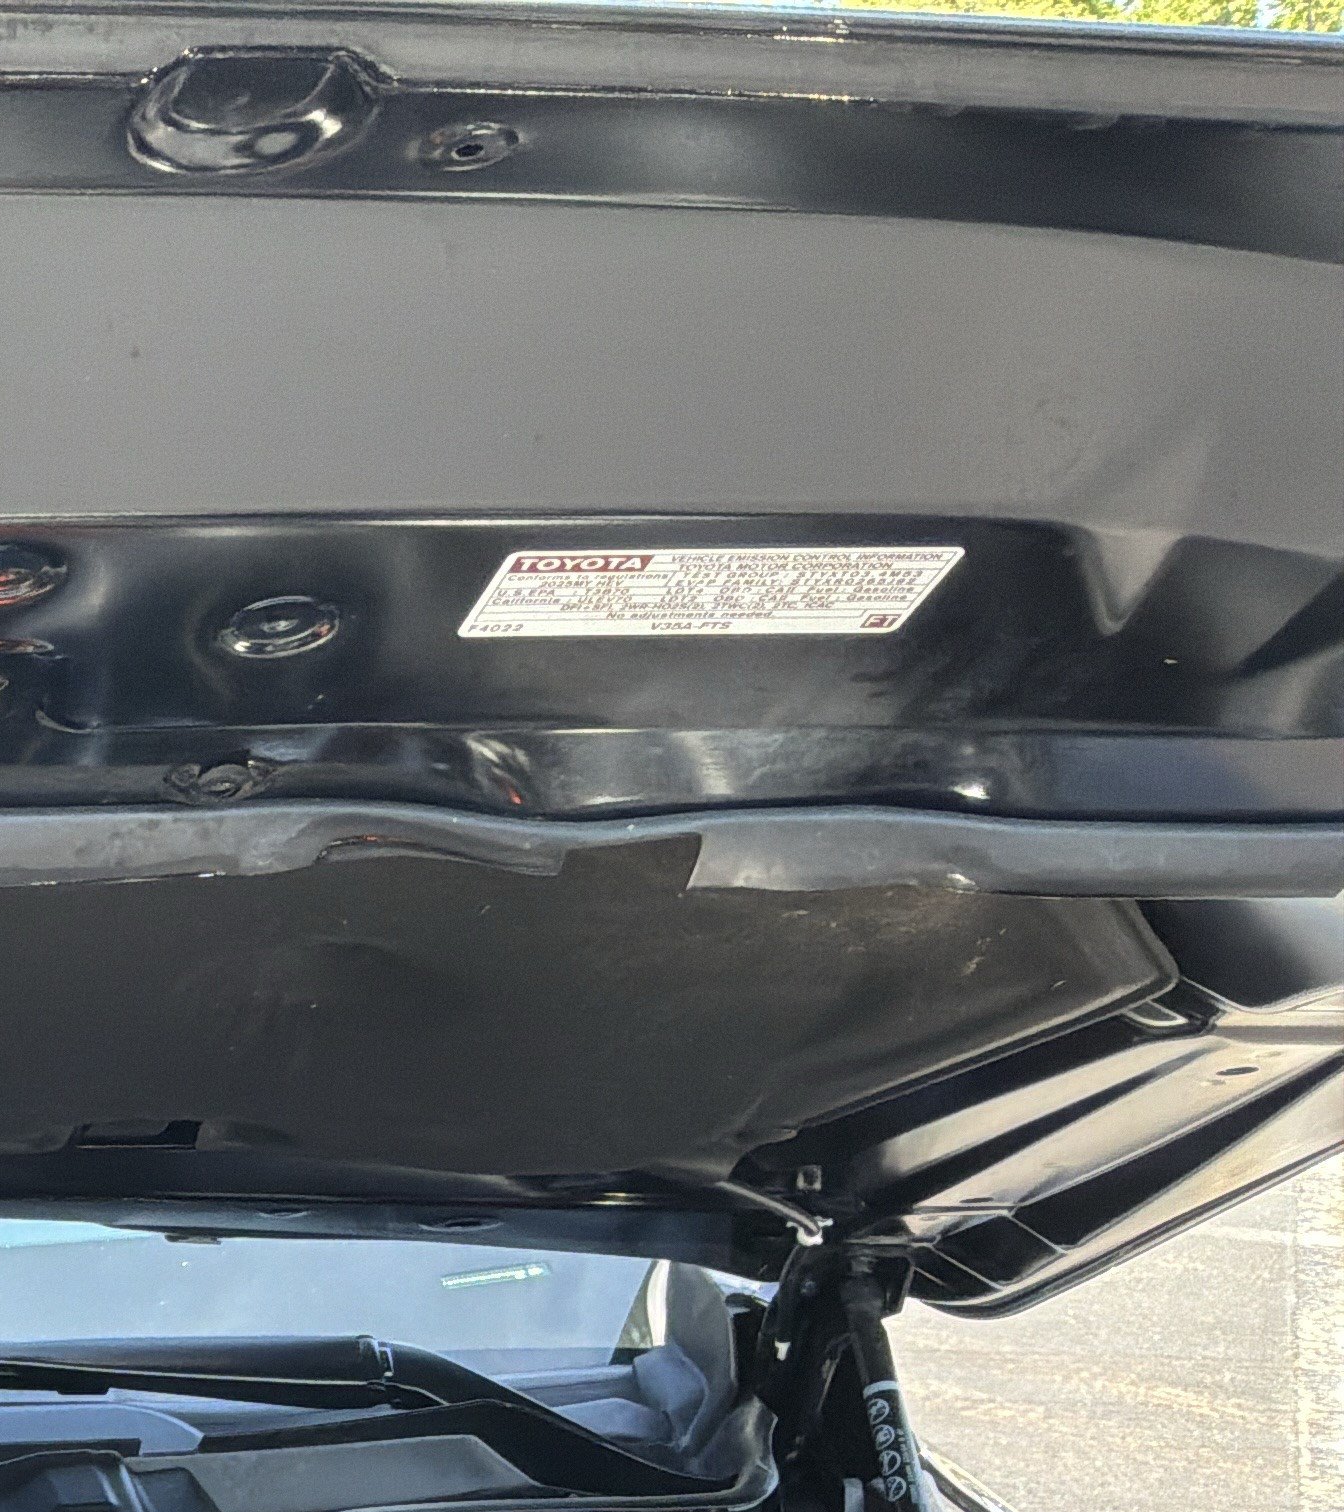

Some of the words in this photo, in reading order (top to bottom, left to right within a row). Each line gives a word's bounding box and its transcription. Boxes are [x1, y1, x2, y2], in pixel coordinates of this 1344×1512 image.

[671, 555, 725, 563] VEHICLE
[727, 554, 790, 562] EMISSION
[792, 553, 852, 562] CONTROL
[856, 553, 943, 561] INFORMATION
[518, 558, 643, 571] TOYOTA
[678, 563, 732, 571] TOYOTA
[791, 562, 894, 570] CORPORATION
[507, 574, 571, 582] Conforms
[594, 573, 670, 582] regulations
[683, 571, 721, 579] TEST
[538, 580, 593, 588] 2025MY
[596, 579, 624, 588] HEV
[674, 579, 717, 587] EVAP
[852, 585, 915, 594] Gasoline
[491, 596, 561, 605] California
[846, 593, 909, 602] Gasoline
[605, 611, 626, 619] No
[629, 611, 716, 620] adjustments
[467, 623, 524, 633] F4022
[650, 621, 733, 631] V35A-FTS
